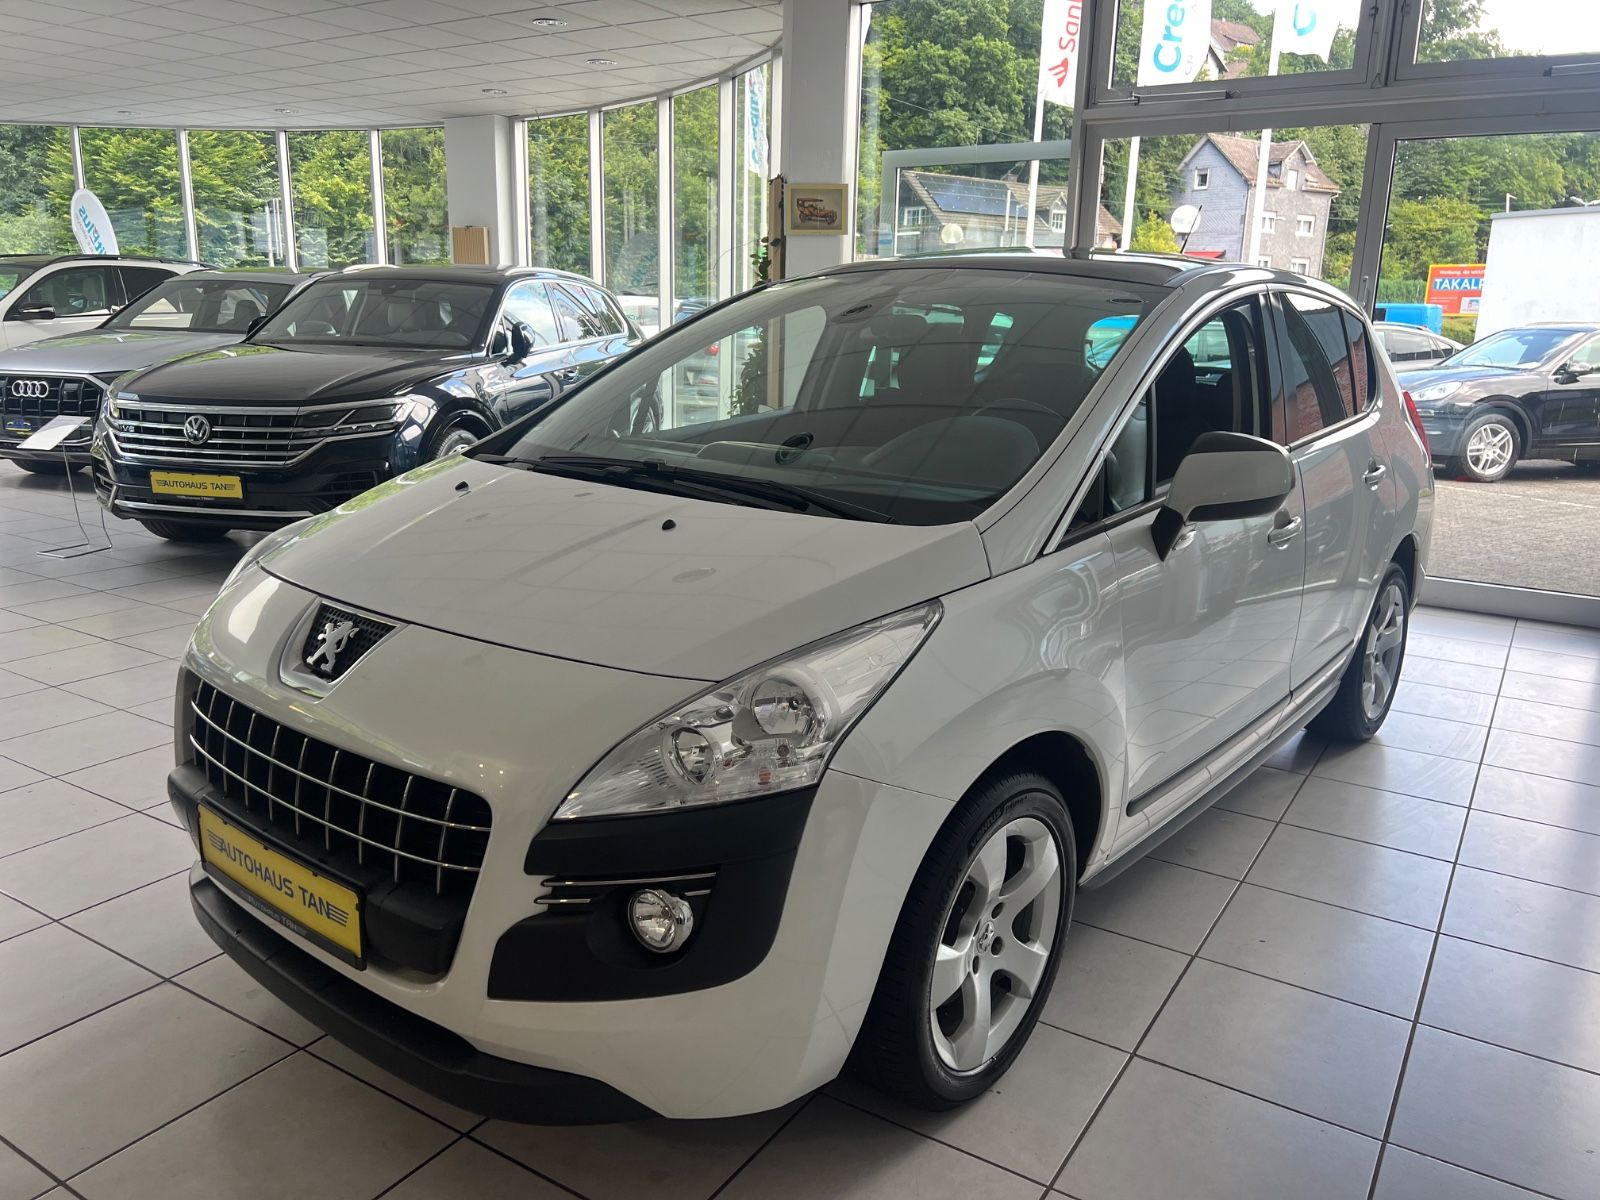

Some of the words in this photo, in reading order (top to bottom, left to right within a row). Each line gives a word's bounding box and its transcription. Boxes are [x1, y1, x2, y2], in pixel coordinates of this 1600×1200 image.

[1058, 0, 1083, 53] San
[1153, 0, 1185, 73] Cre
[163, 480, 208, 490] AUTOHAUS
[210, 482, 227, 490] TAN
[220, 839, 294, 898] AUTOHAUS
[298, 885, 331, 919] TAN
